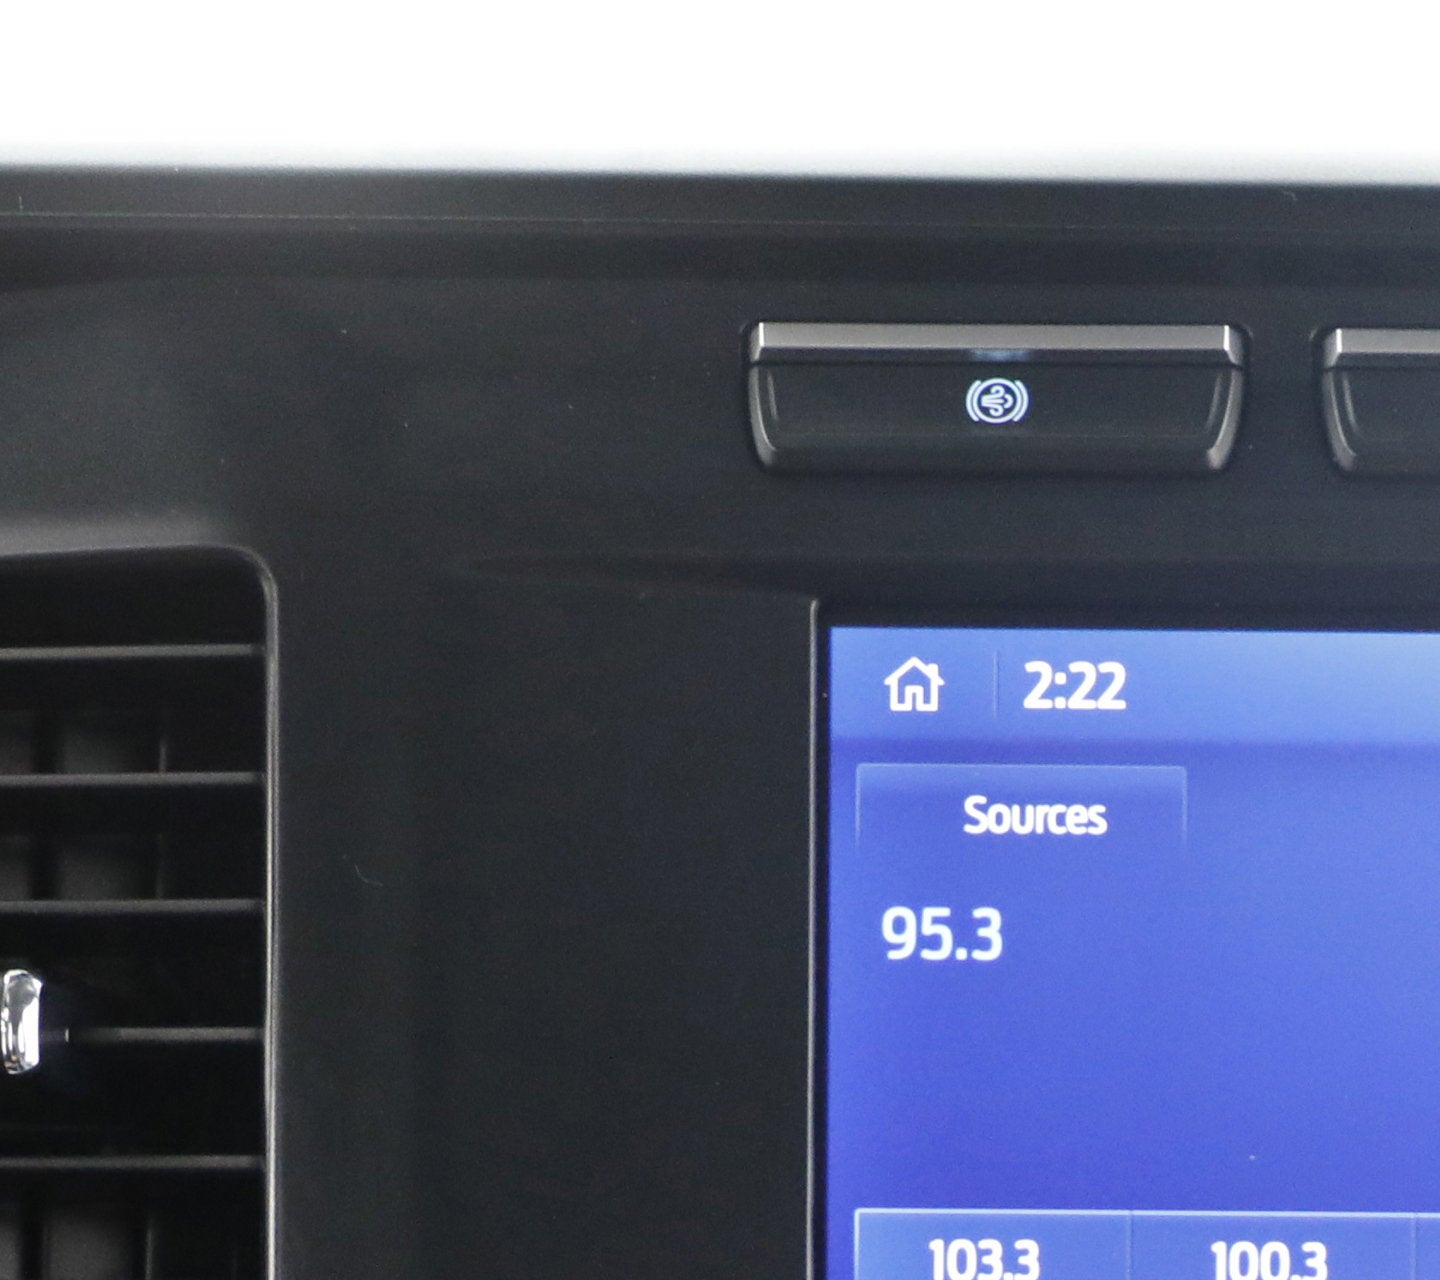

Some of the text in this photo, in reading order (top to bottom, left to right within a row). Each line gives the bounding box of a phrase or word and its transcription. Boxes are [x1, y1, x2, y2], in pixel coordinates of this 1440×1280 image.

[1023, 661, 1126, 709] 2:22
[963, 795, 1108, 836] Sources
[881, 907, 1004, 961] 95.3
